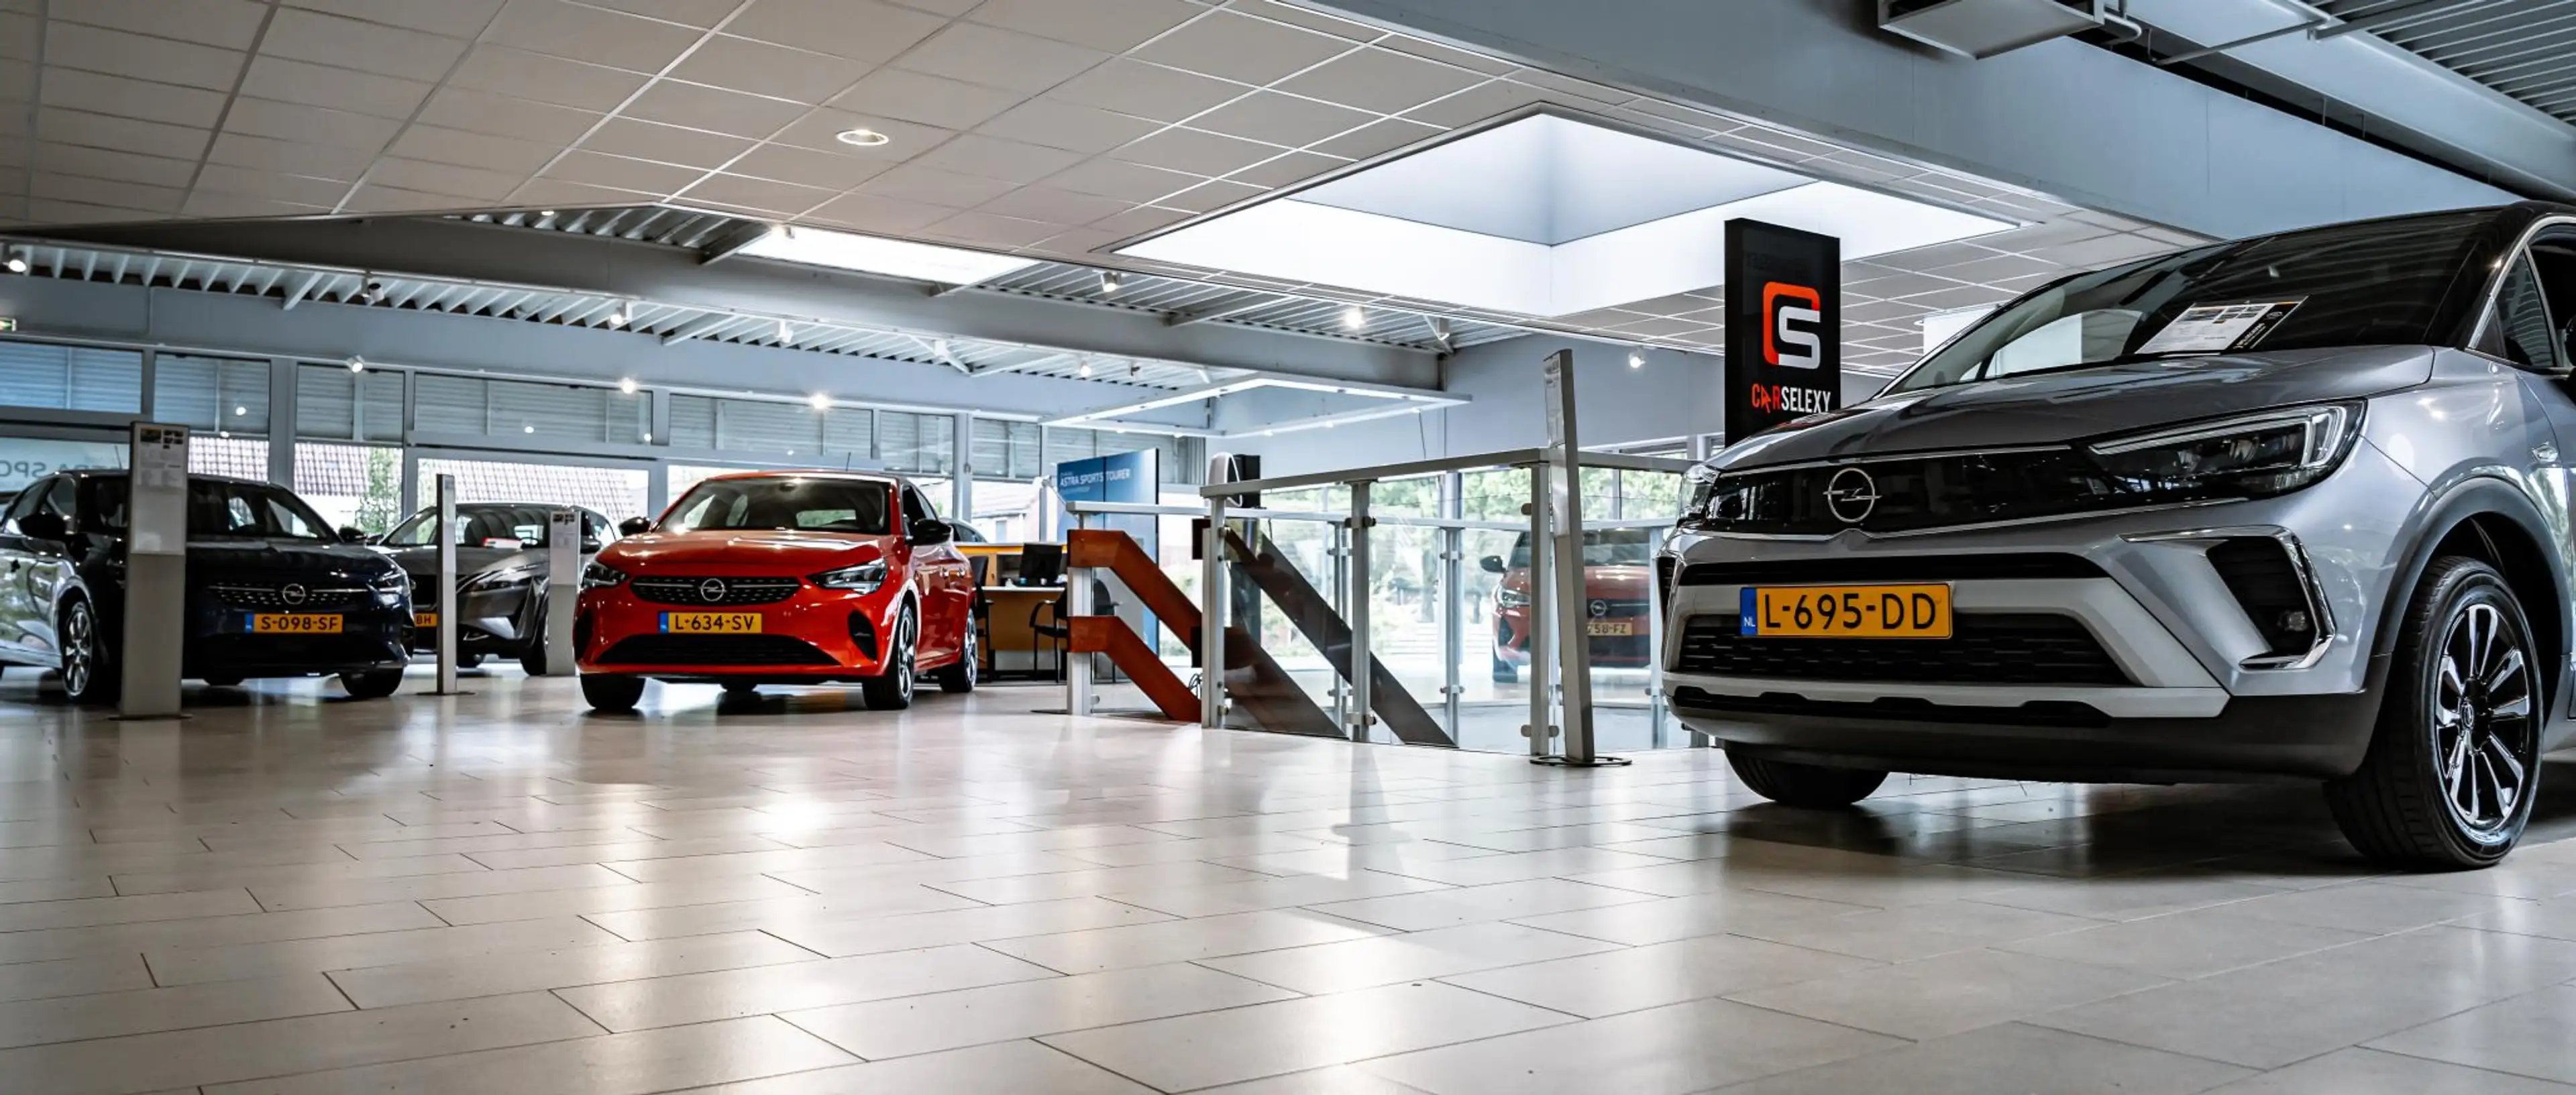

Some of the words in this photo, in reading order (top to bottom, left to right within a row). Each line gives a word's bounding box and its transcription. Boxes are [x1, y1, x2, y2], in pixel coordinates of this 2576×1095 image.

[1752, 383, 1831, 414] CARSELEXY
[1060, 475, 1079, 487] ASTRA
[1080, 471, 1104, 484] SPORTS
[1106, 468, 1130, 481] TOURER
[1764, 593, 1936, 630] L-695-DD
[261, 616, 338, 630] S-098-SF
[675, 614, 754, 630] L-634-SV
[1744, 617, 1756, 627] NL
